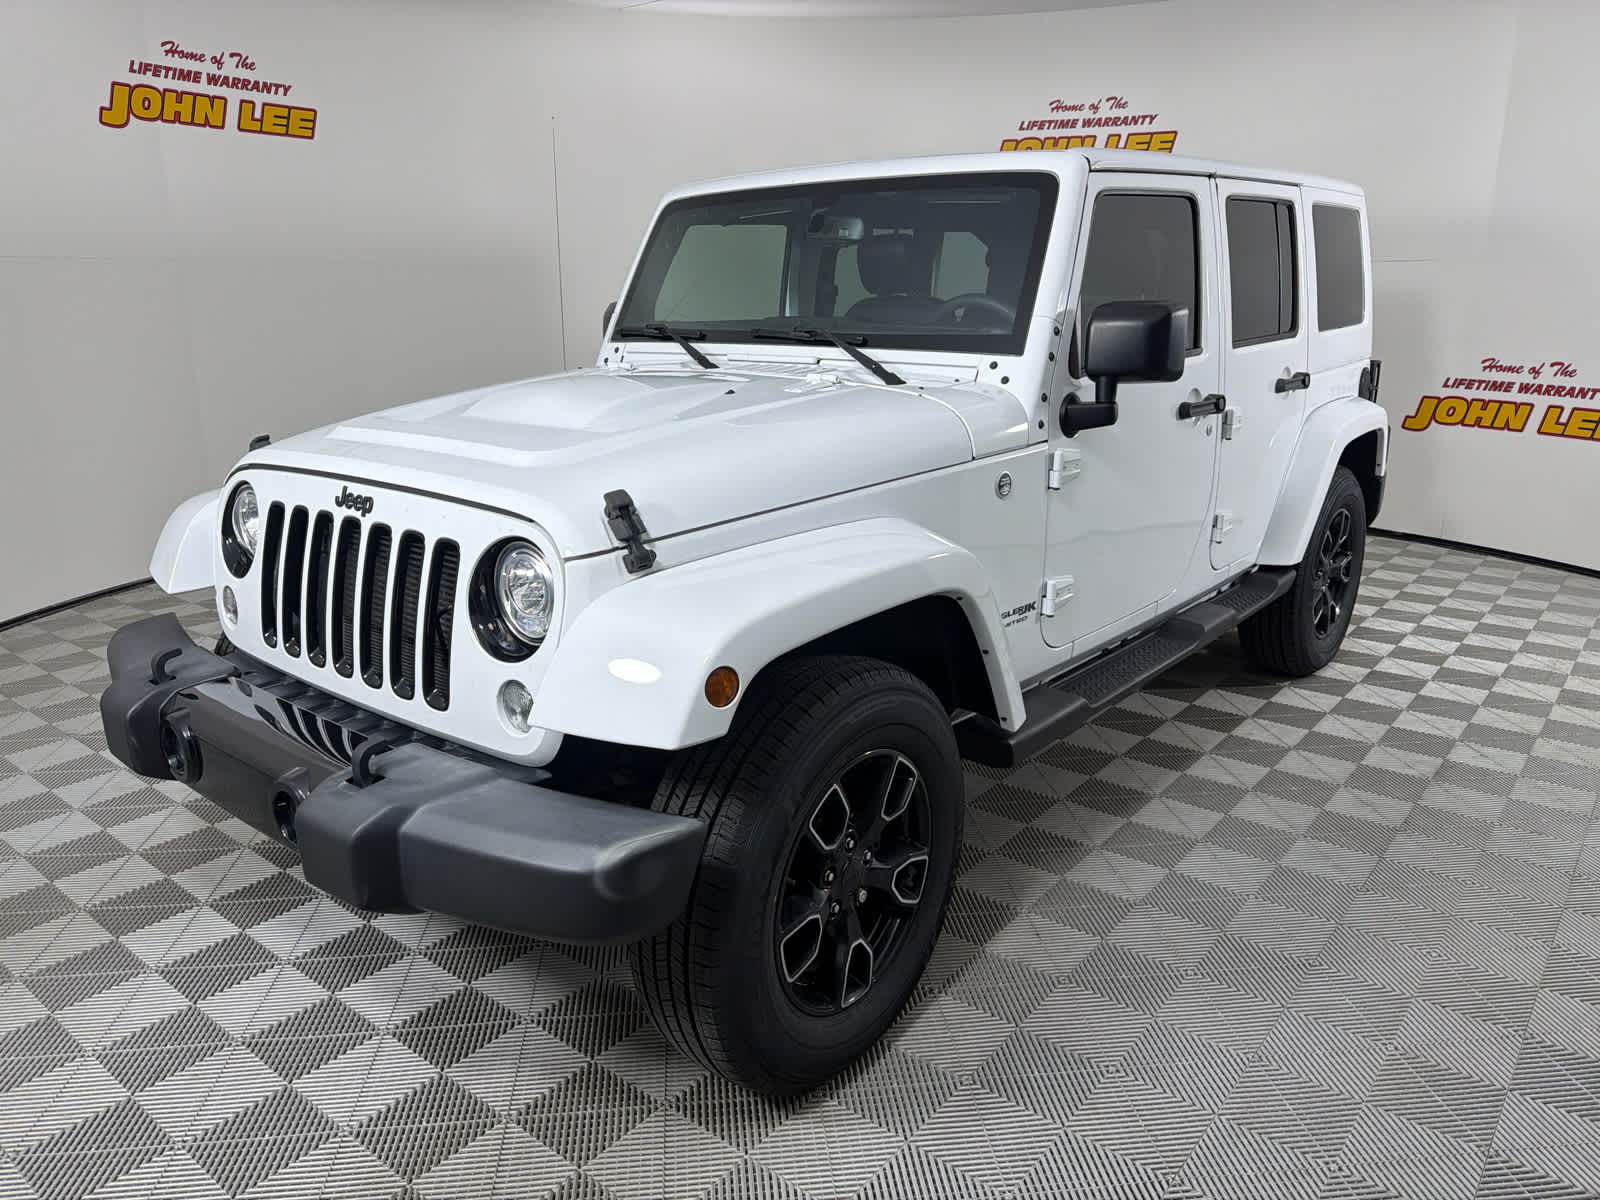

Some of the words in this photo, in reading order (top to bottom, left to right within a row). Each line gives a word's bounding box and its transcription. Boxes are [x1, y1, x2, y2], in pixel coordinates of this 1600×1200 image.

[160, 41, 206, 62] Home
[210, 52, 225, 70] of
[228, 52, 256, 71] The
[128, 60, 203, 84] LIFETIME
[206, 72, 292, 96] WARRANTY
[99, 81, 228, 129] JOHN
[237, 98, 317, 140] LEE
[1049, 99, 1085, 113] Home
[1088, 98, 1102, 114] of
[1105, 96, 1128, 110] The
[1018, 118, 1079, 131] LIFETIME
[1081, 114, 1158, 129] WARRANTY
[1480, 357, 1524, 375] Home
[1527, 362, 1545, 379] of
[1549, 361, 1577, 378] The
[1442, 377, 1515, 393] LIFETIME
[1517, 382, 1600, 400] WARRANT
[1401, 395, 1534, 432] JOHN
[335, 485, 374, 517] Jeep
